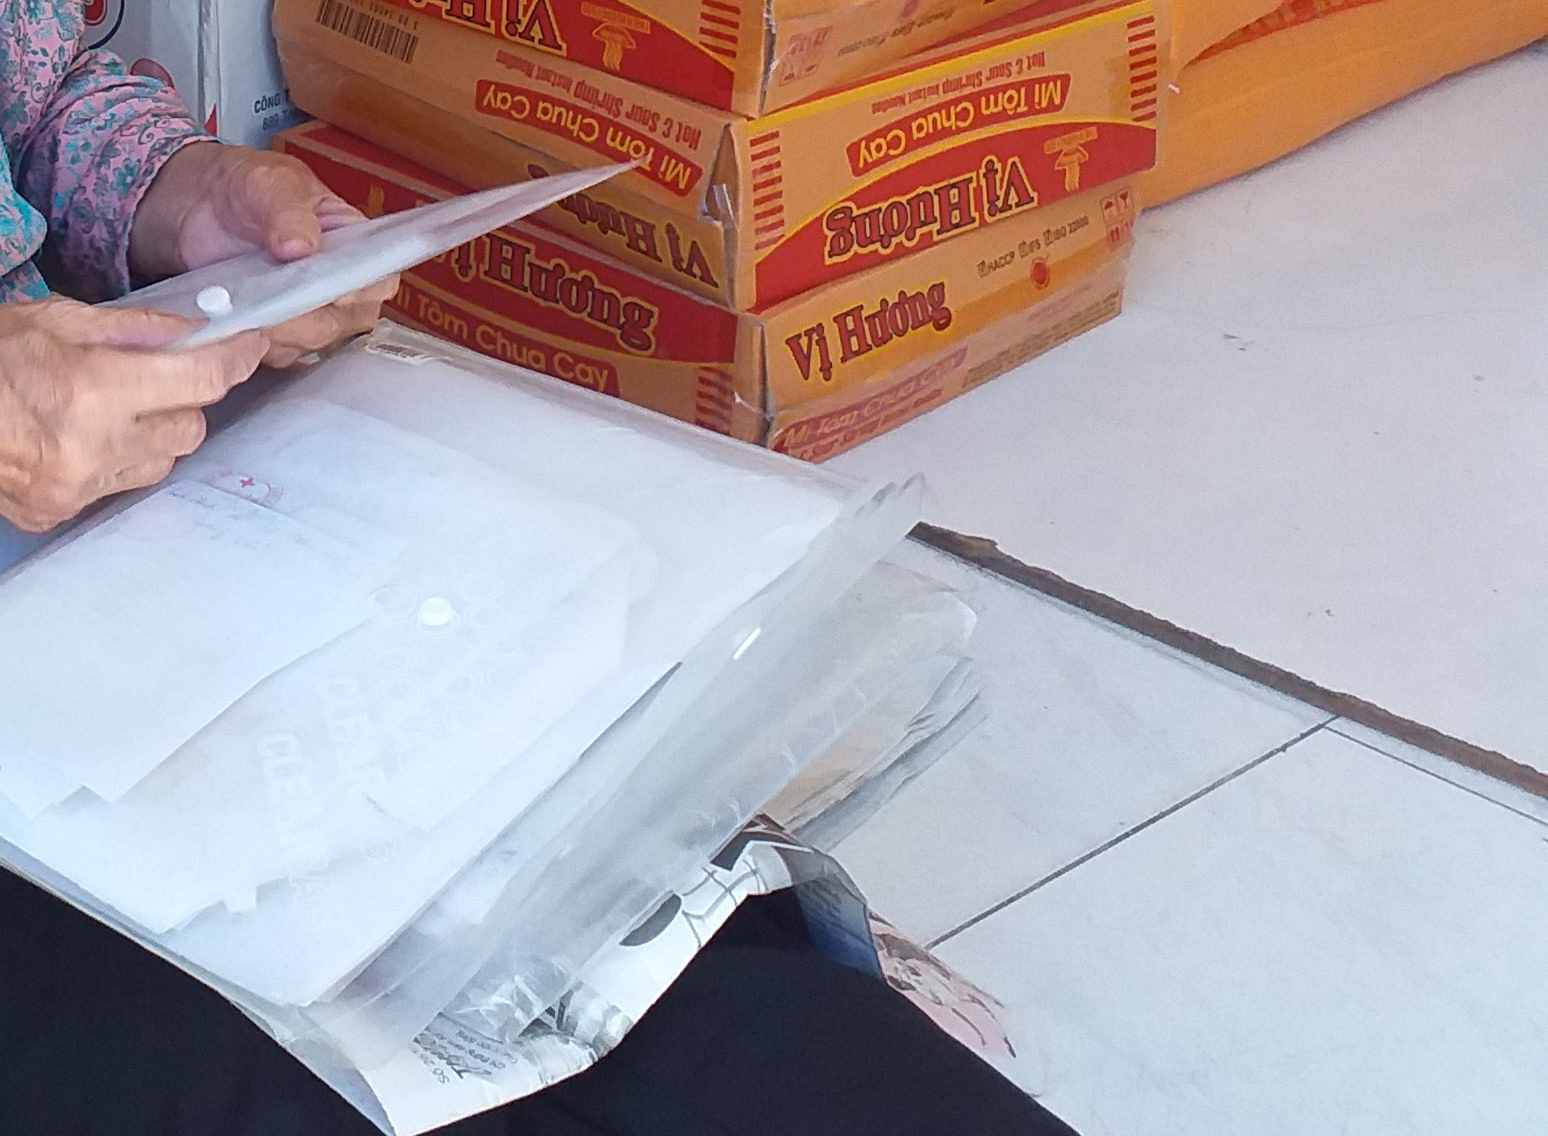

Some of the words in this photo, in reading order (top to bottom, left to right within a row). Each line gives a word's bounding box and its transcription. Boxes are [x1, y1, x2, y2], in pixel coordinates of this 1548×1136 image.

[483, 84, 530, 119] Cay
[537, 100, 600, 143] Chua
[912, 101, 974, 139] Chua
[981, 86, 1028, 115] Tôm
[859, 129, 905, 167] Cay
[983, 159, 1034, 217] Vị
[826, 176, 976, 258] Hương
[485, 233, 654, 351] Hương
[417, 293, 468, 340] Tôm
[476, 324, 545, 369] Chua
[552, 353, 608, 389] Cay
[785, 323, 833, 381] Vị
[834, 282, 952, 363] Hương
